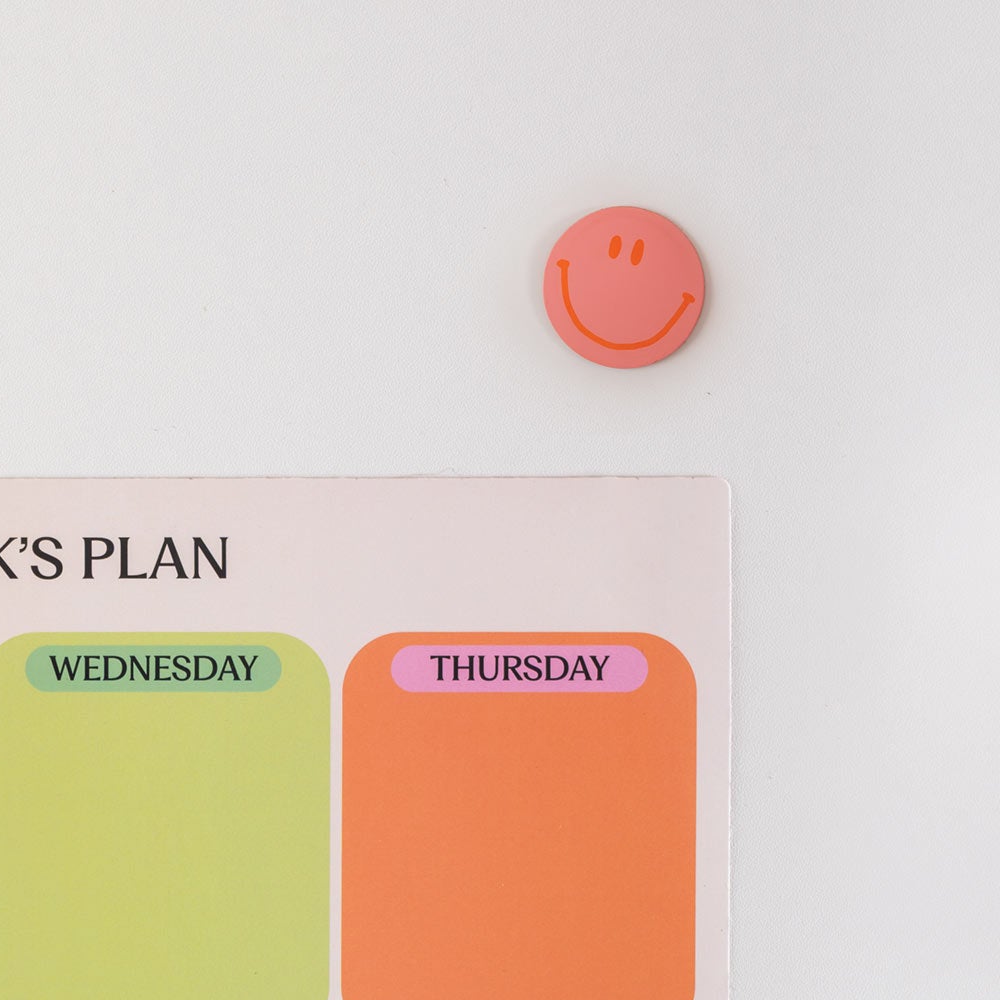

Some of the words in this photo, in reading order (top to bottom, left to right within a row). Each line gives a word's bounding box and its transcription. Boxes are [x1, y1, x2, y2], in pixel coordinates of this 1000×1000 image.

[82, 536, 228, 581] PLAN
[49, 655, 259, 682] WEDNESDAY
[430, 655, 610, 682] THURSDAY
